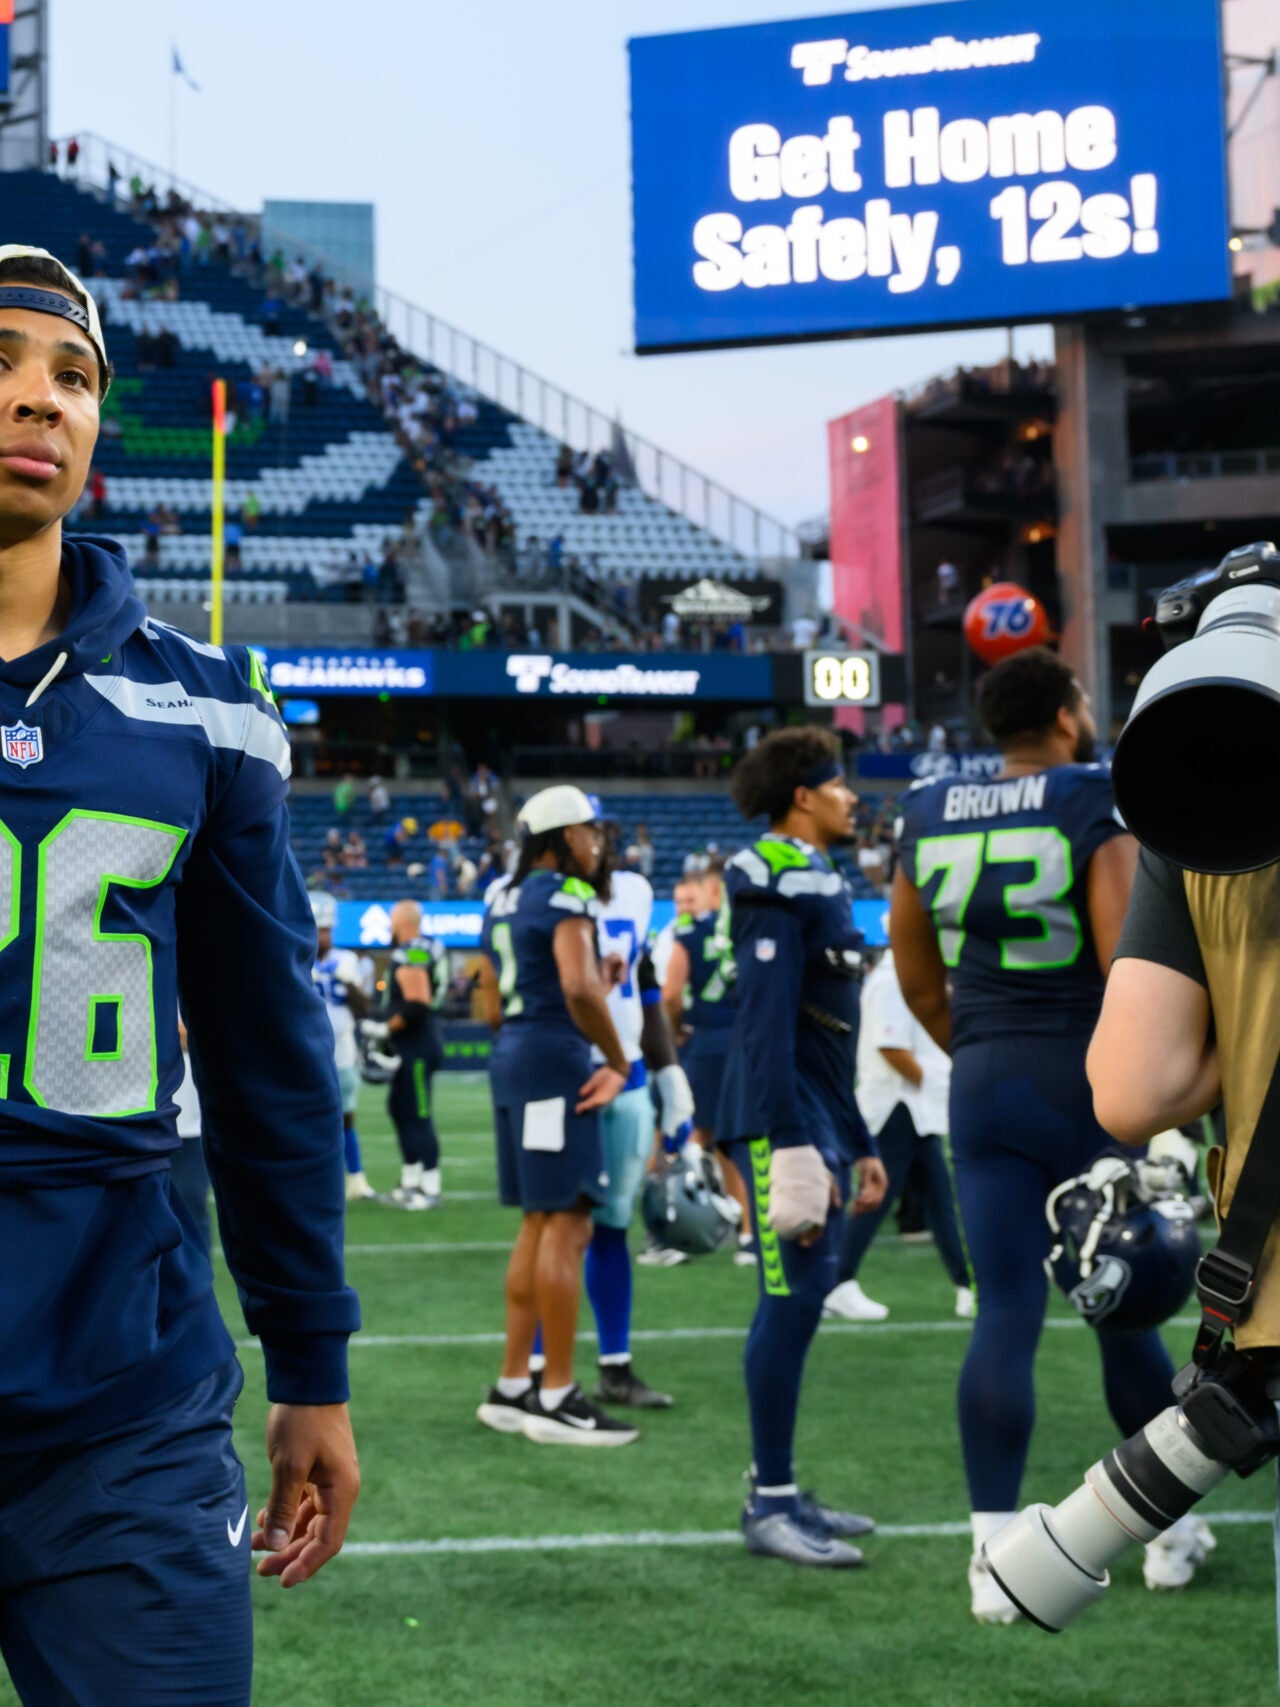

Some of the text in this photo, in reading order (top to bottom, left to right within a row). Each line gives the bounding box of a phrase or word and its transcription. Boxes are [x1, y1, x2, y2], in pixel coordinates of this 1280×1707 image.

[728, 104, 1117, 202] Get Home
[692, 172, 1159, 294] Safely, 12s!
[980, 599, 1033, 639] 76
[813, 656, 870, 700] 00
[9, 741, 38, 759] NFL
[943, 775, 1047, 820] BROWN
[916, 826, 1084, 970] 73
